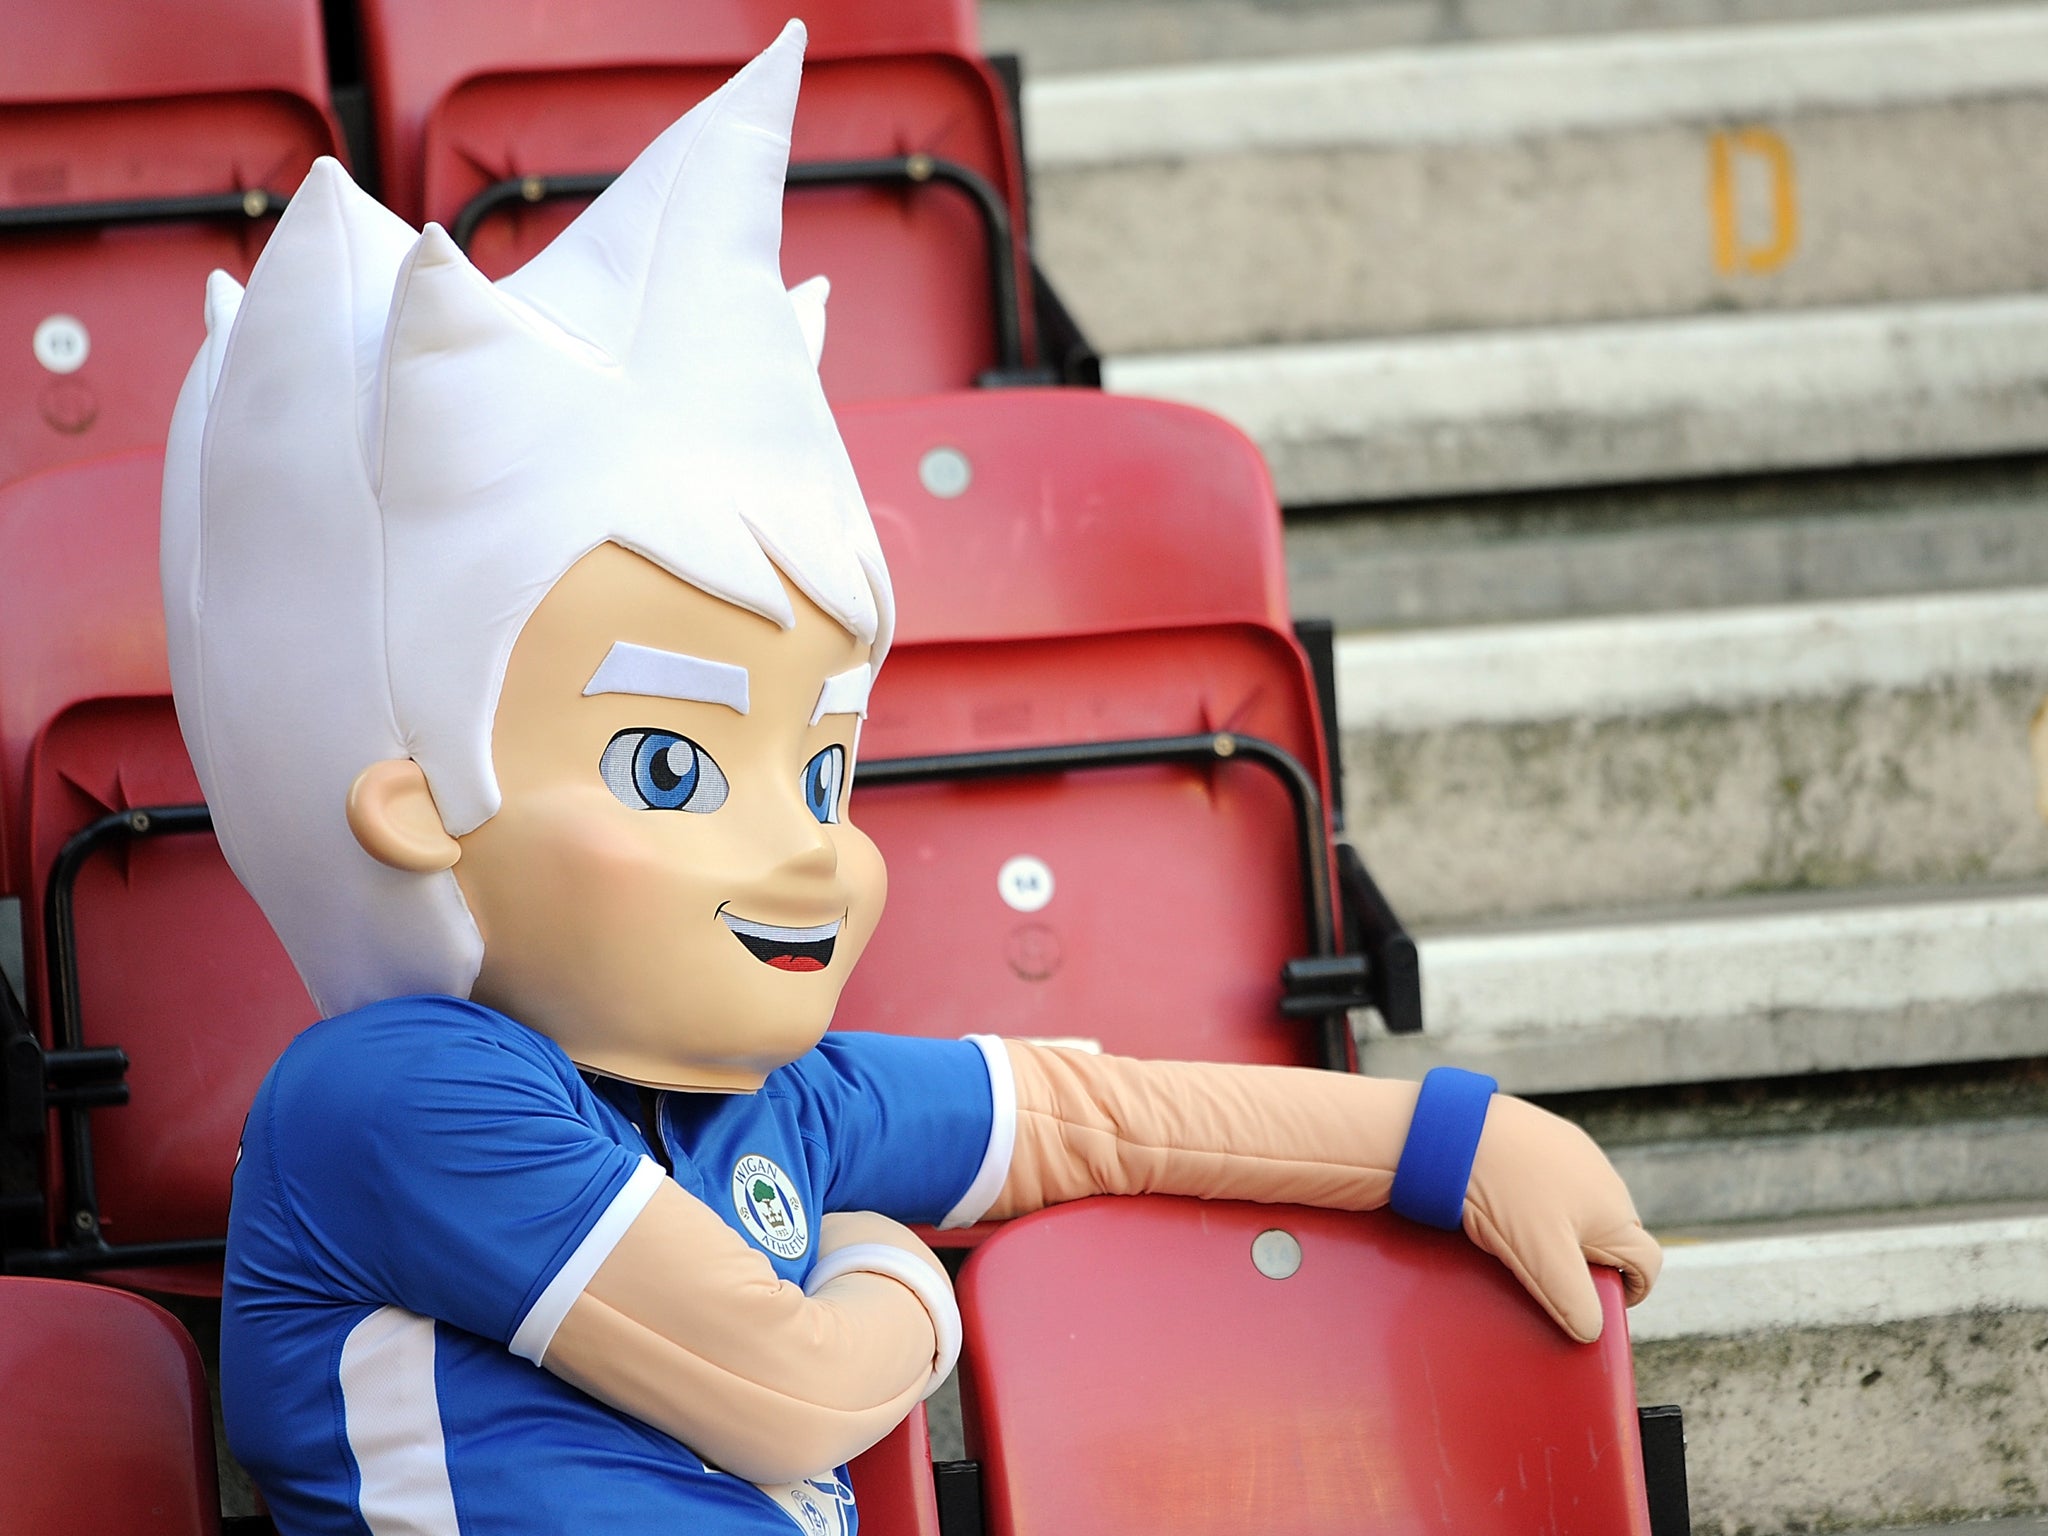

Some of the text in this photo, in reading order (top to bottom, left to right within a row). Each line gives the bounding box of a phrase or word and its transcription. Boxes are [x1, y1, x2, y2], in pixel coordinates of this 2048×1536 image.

[1709, 128, 1798, 277] D
[735, 1157, 776, 1185] WIGAN
[761, 1228, 806, 1256] ATHLETIC
